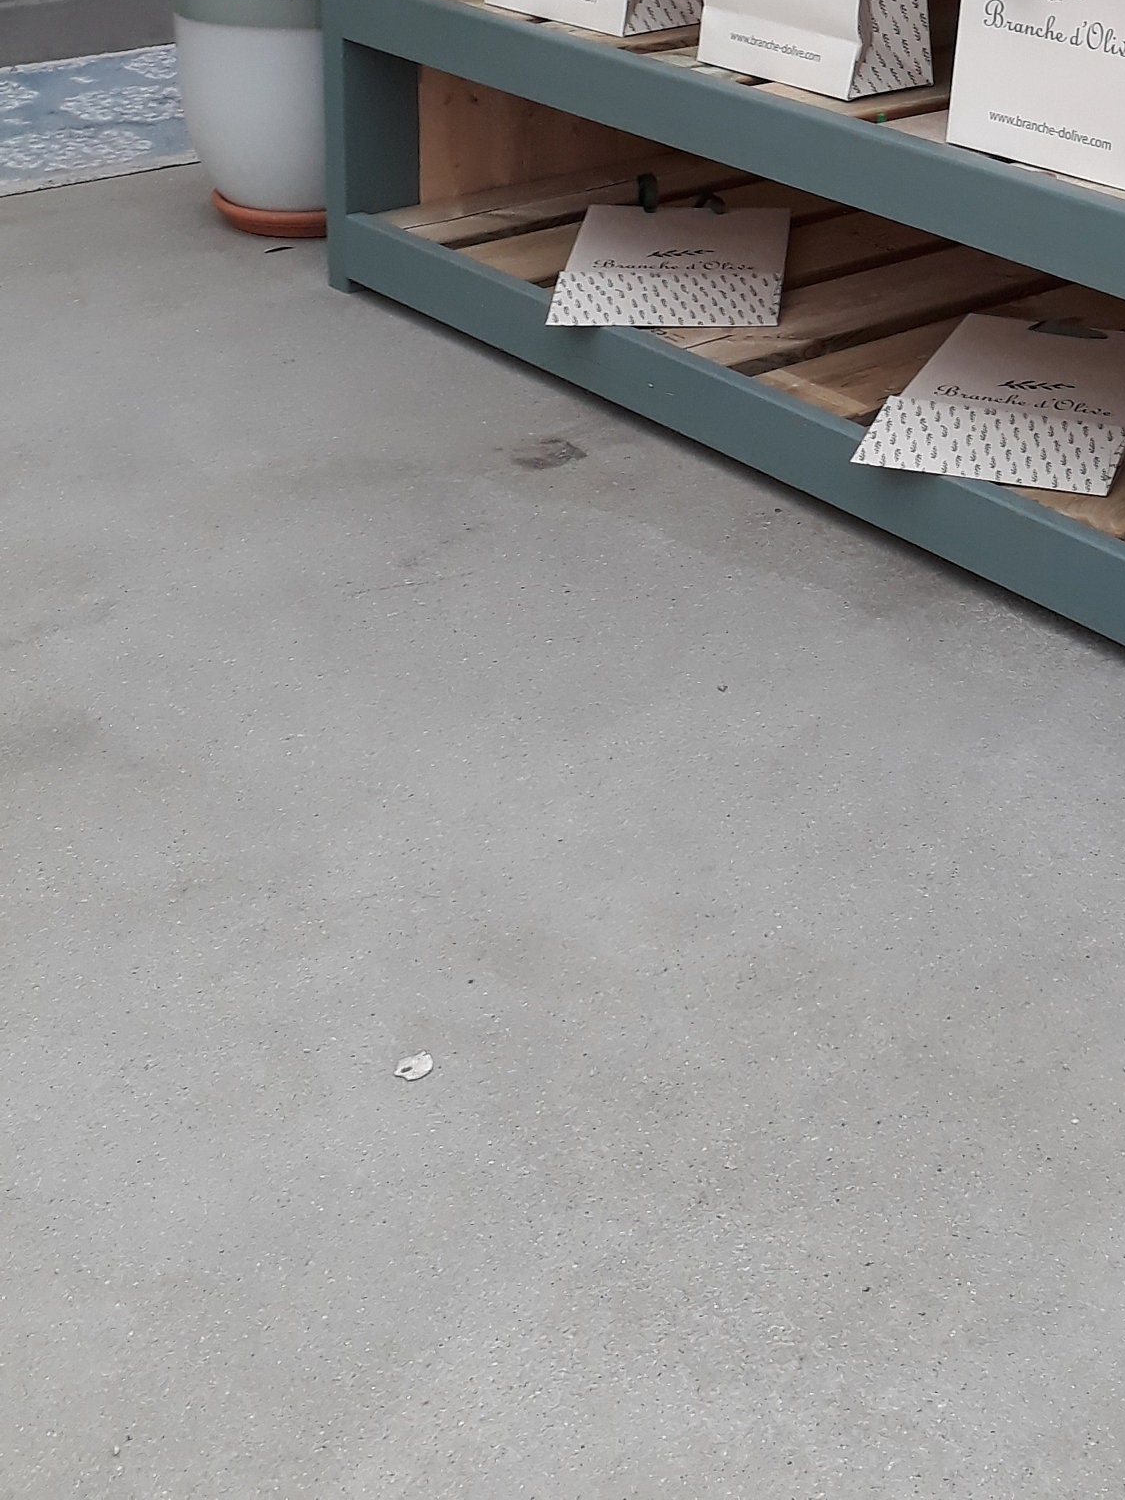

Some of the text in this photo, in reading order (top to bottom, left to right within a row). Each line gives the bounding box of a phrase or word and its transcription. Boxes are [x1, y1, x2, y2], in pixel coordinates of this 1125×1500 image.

[729, 32, 821, 63] www.branche-dolive.com
[988, 110, 1112, 151] www.branche-dolive.com
[592, 258, 678, 270] Branche
[933, 384, 1113, 417] Branche d'Olive
